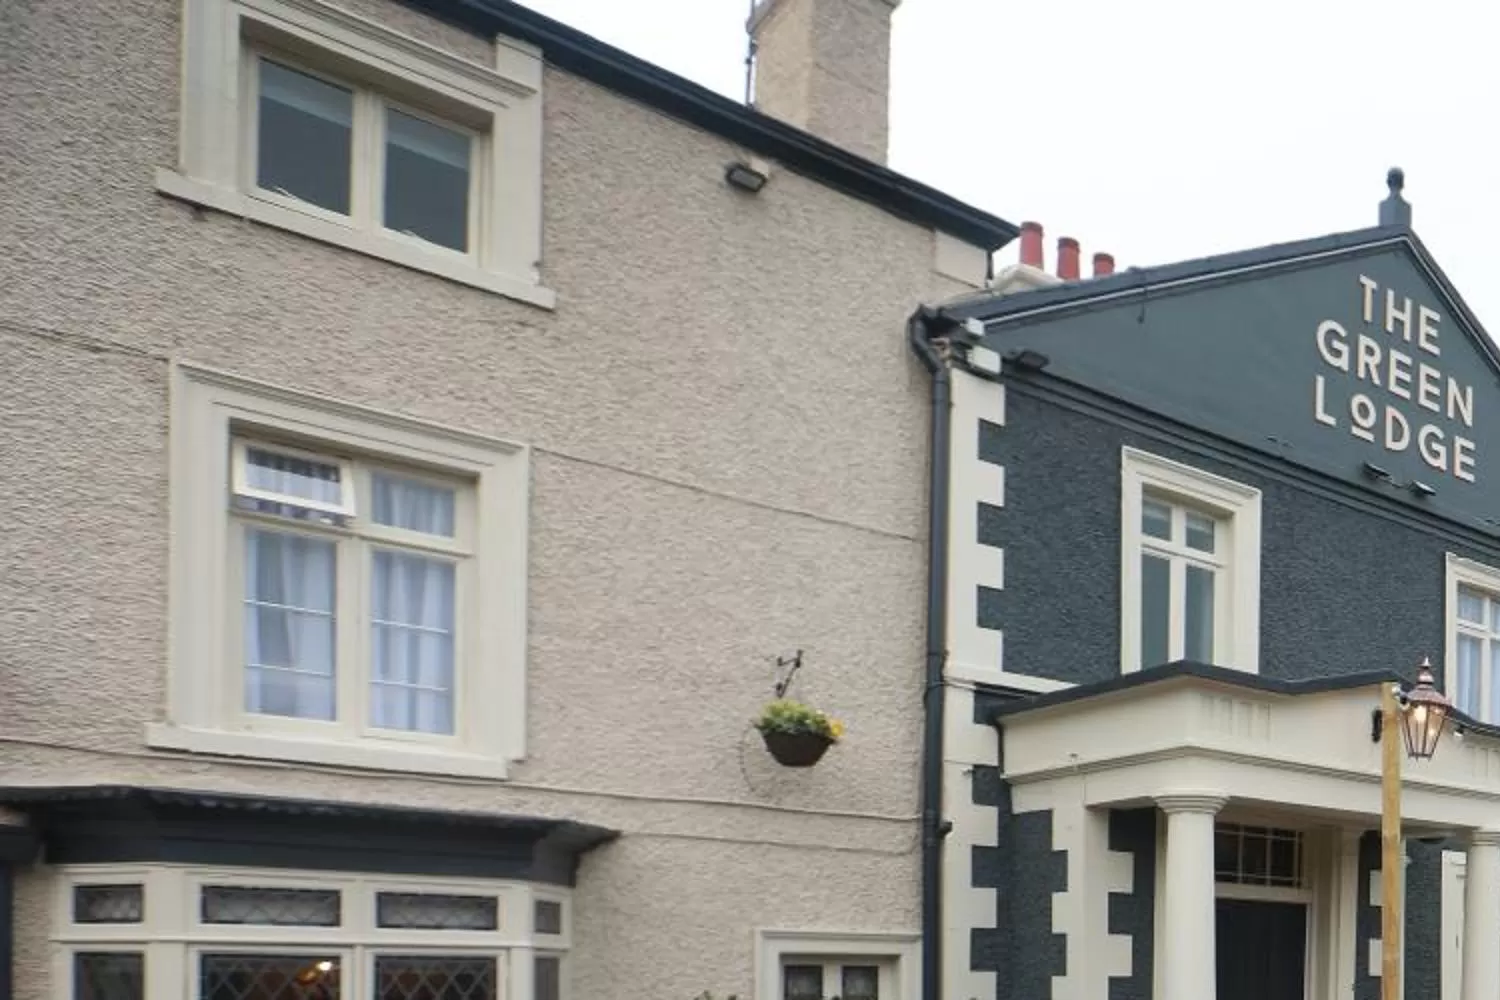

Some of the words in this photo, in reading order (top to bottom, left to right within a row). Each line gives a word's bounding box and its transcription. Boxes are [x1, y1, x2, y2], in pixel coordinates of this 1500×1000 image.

[1359, 274, 1441, 356] THE
[1316, 319, 1474, 428] GREEN
[1315, 374, 1477, 483] LODGE
